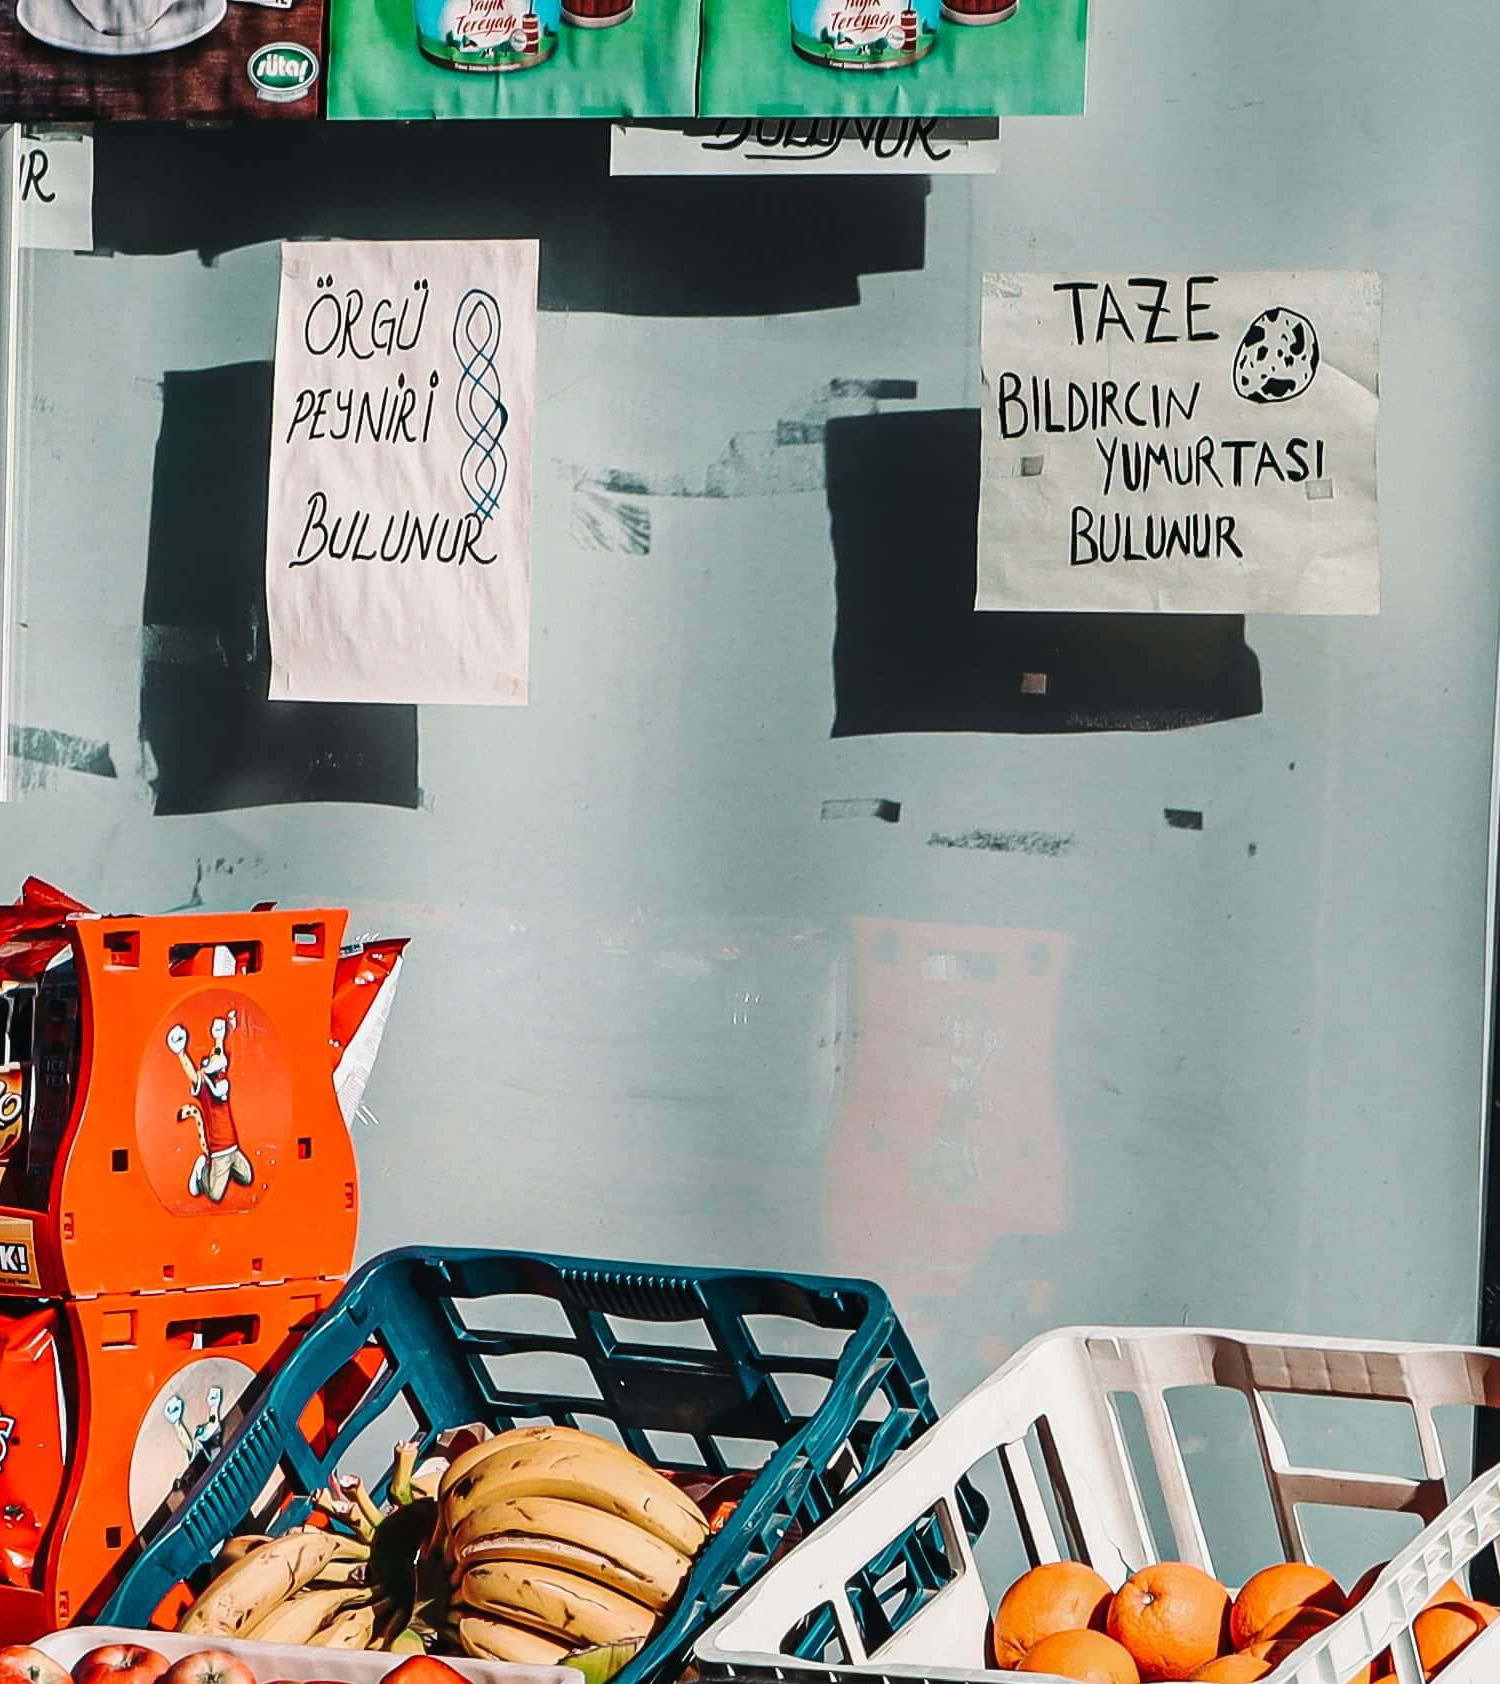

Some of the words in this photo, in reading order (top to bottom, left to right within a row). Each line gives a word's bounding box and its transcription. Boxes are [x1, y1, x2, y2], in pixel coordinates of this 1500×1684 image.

[304, 273, 429, 360] ÖRGÜ
[1052, 275, 1220, 346] TAZE
[286, 370, 440, 445] PEYNİRİ
[998, 371, 1201, 440] BILDIRCIN
[1095, 434, 1326, 496] YUMURTASI
[288, 490, 499, 569] BULUNUR
[1069, 505, 1244, 567] BULUNUR
